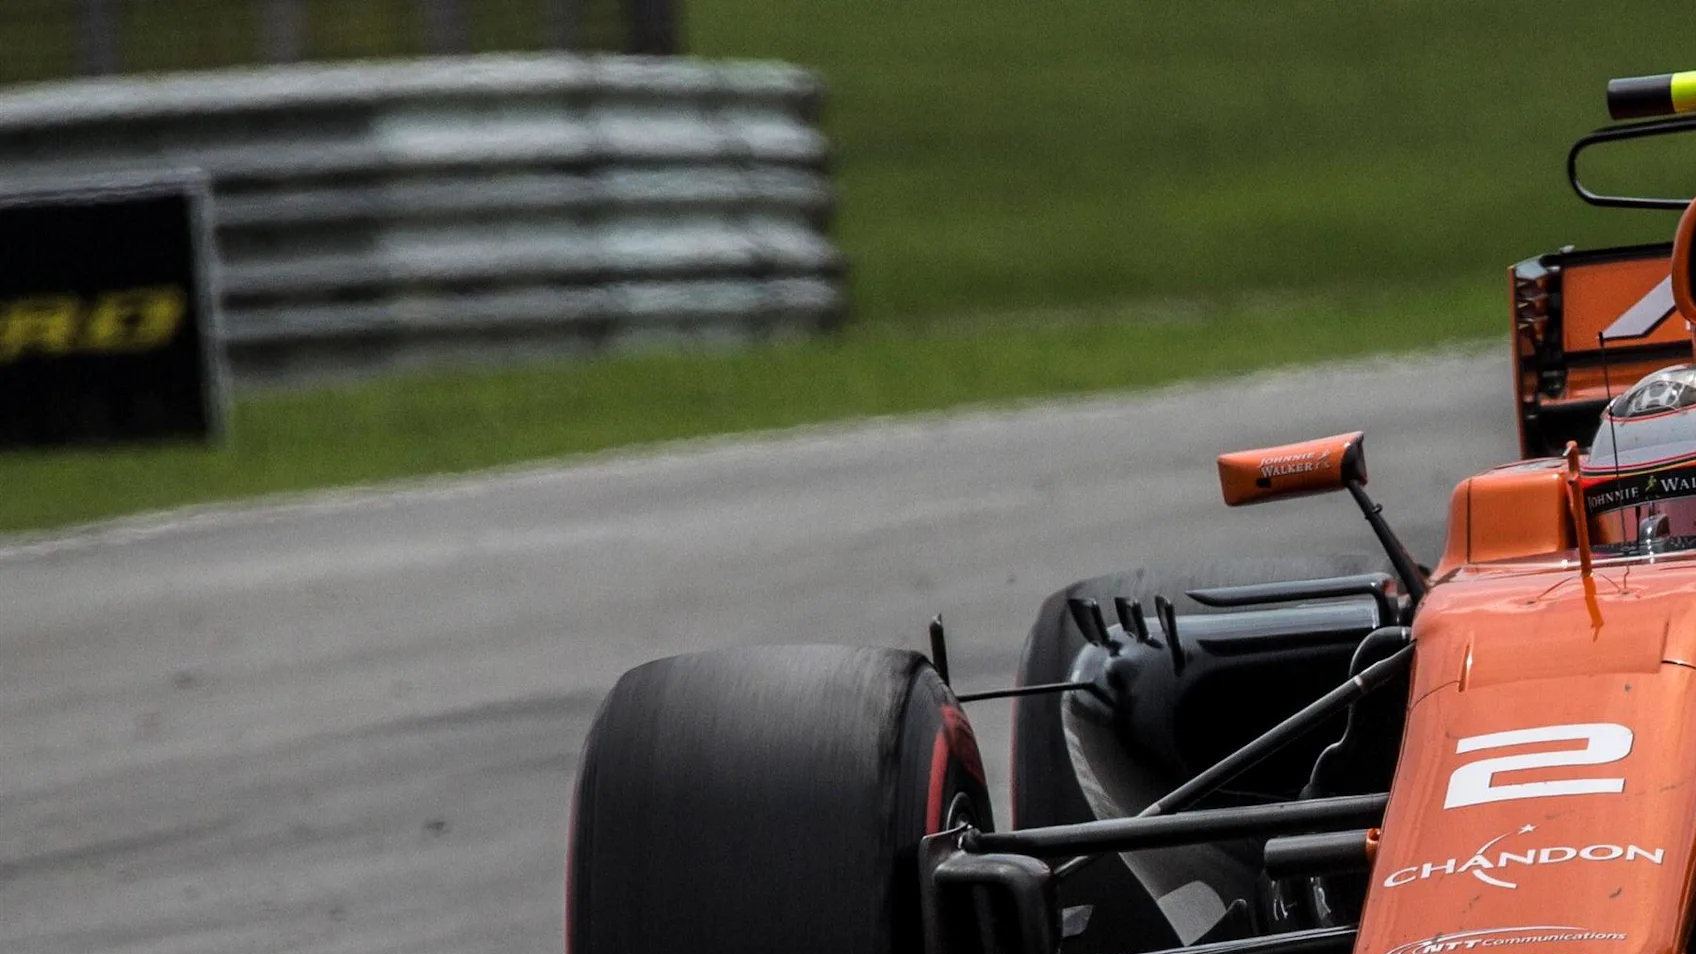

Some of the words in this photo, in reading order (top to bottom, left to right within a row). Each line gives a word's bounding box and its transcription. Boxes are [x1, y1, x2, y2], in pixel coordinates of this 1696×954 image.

[1259, 452, 1315, 467] JOHNNIE
[1261, 462, 1313, 478] WALKER
[1443, 723, 1635, 809] 2
[1383, 842, 1666, 890] CHANDON
[1422, 938, 1484, 954] NTT
